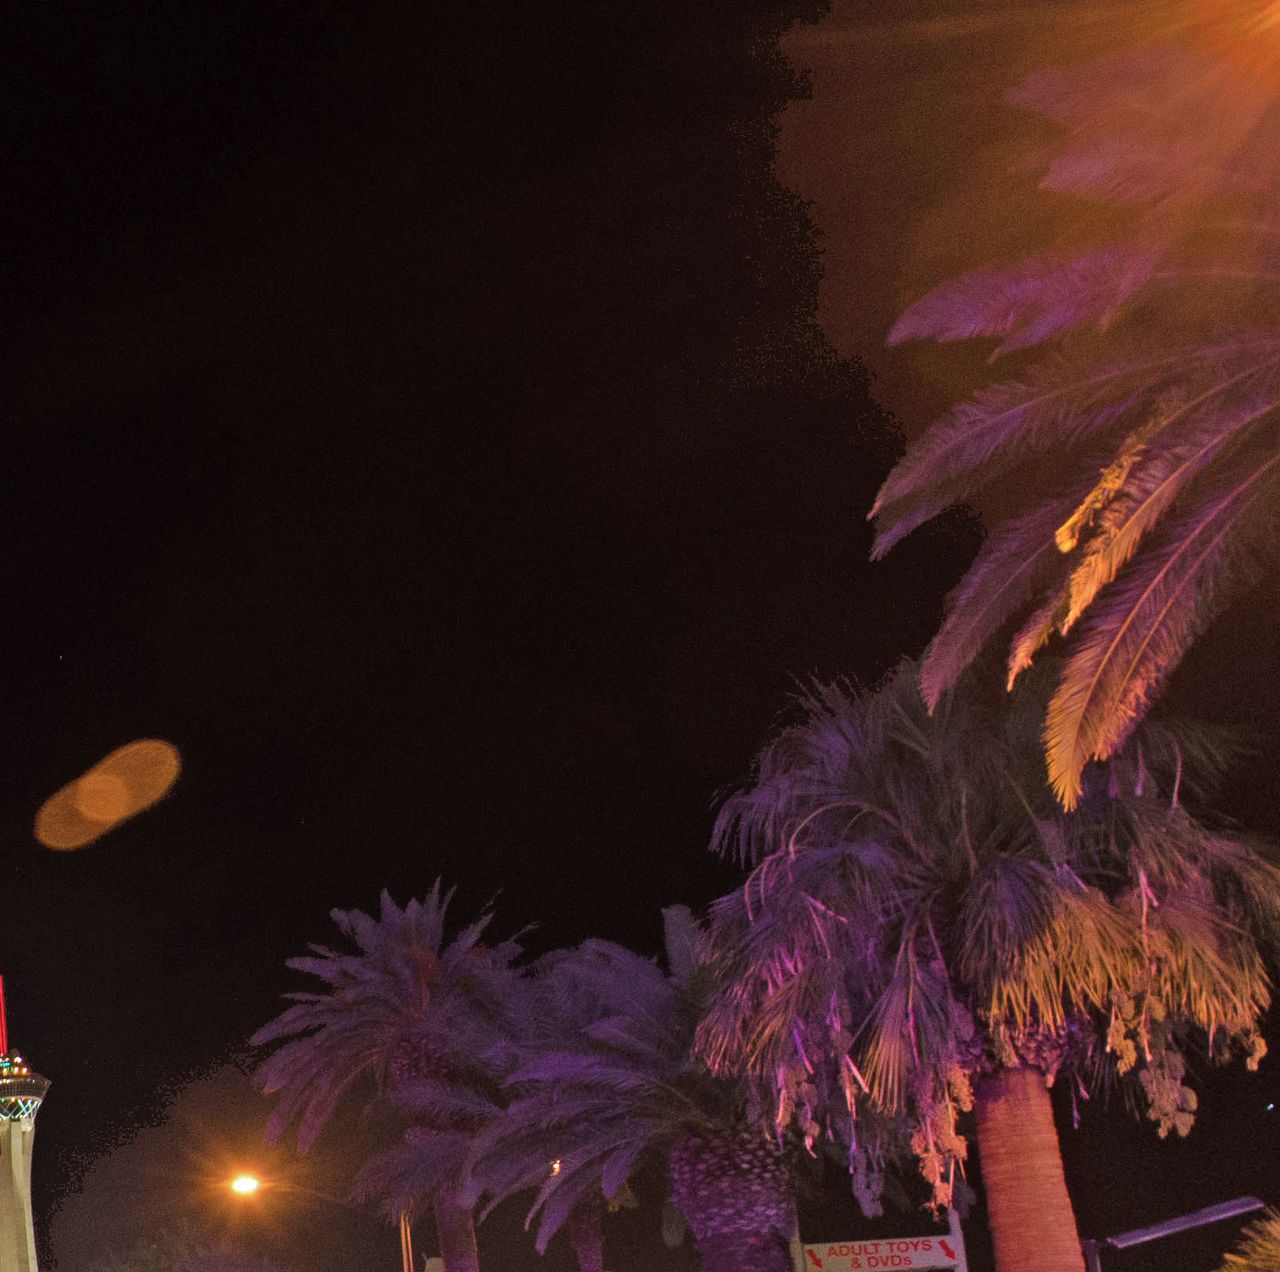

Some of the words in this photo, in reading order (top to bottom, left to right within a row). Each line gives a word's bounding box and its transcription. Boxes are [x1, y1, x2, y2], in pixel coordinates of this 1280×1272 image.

[827, 1242, 880, 1257] ADULT
[886, 1239, 932, 1254] TOYS
[851, 1257, 861, 1269] &
[867, 1255, 912, 1268] DVDs
